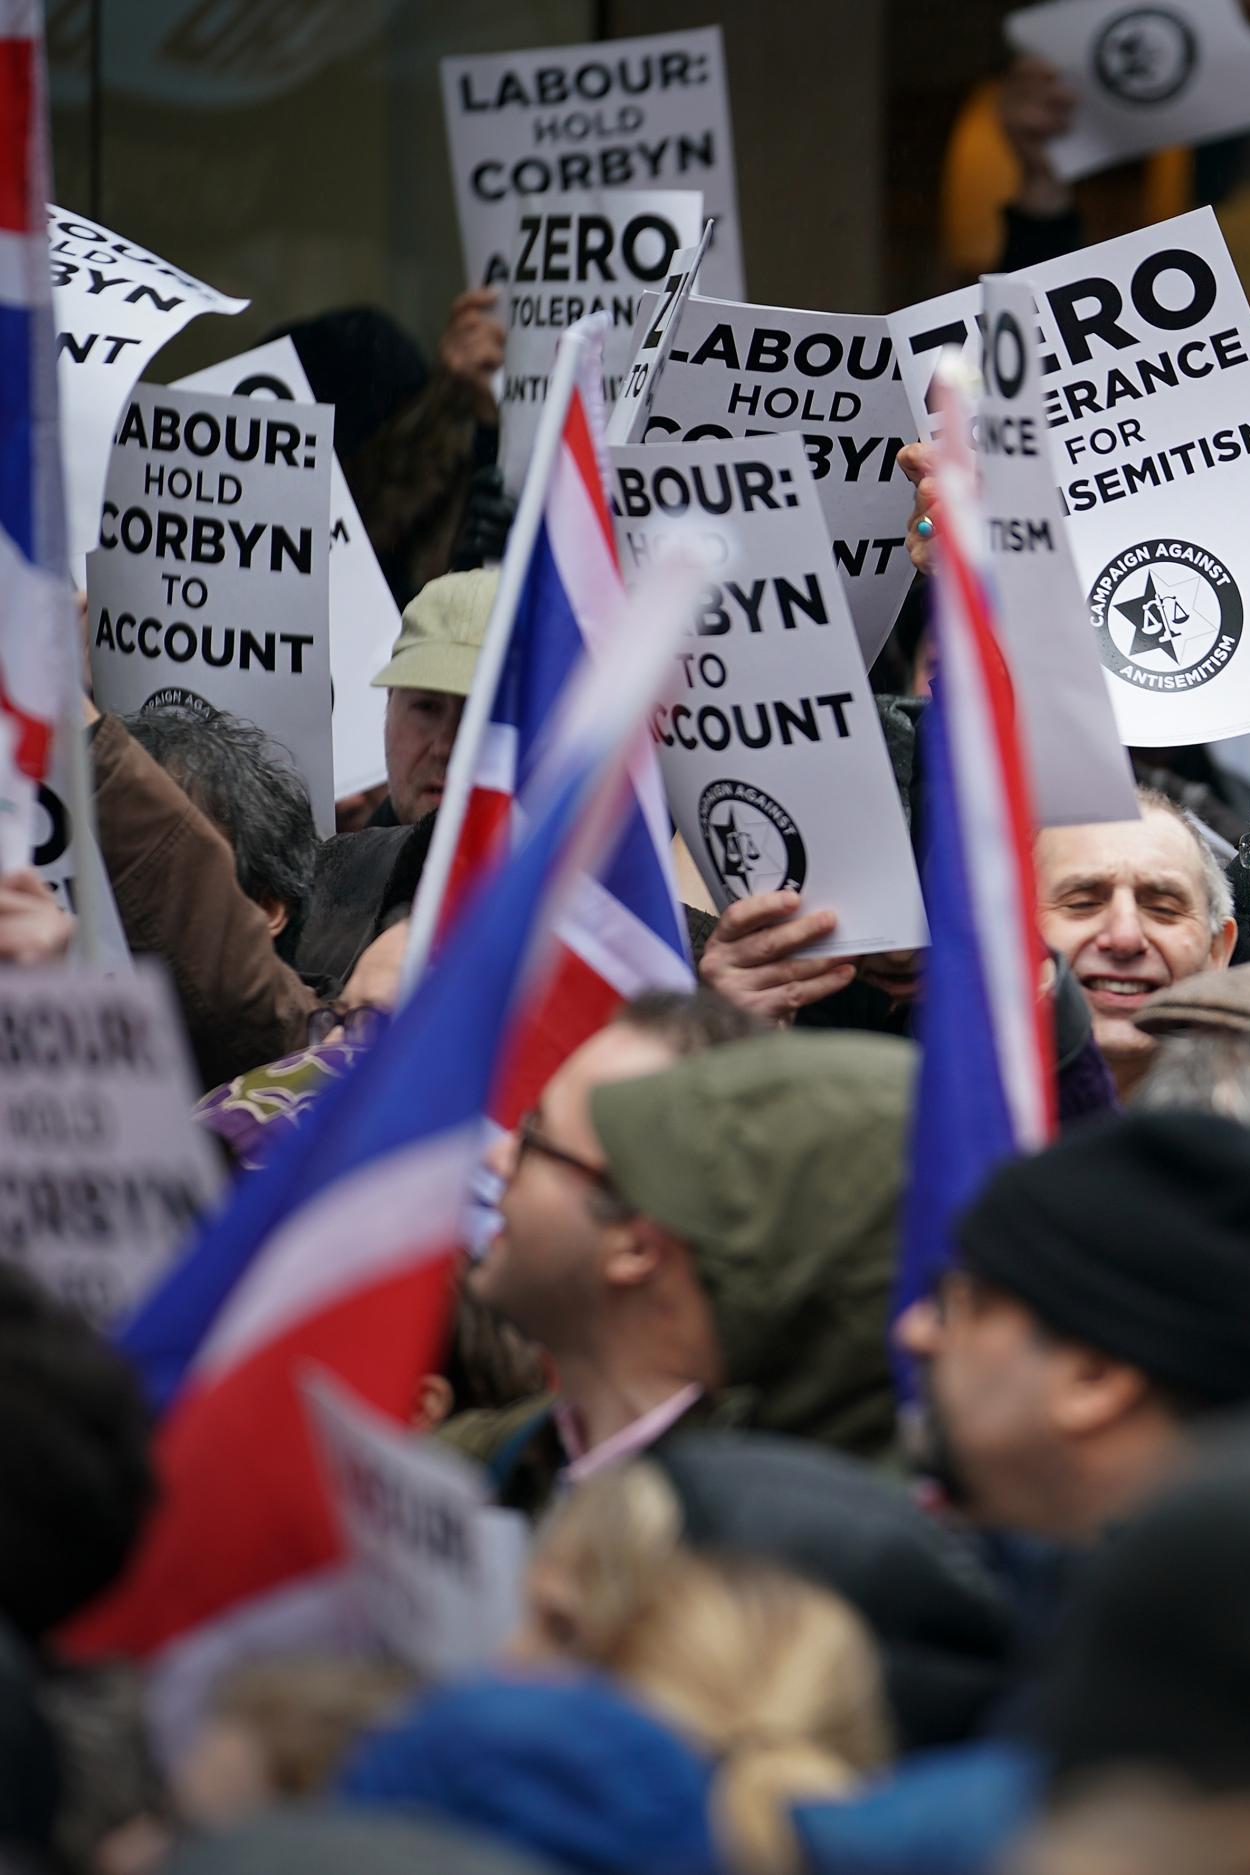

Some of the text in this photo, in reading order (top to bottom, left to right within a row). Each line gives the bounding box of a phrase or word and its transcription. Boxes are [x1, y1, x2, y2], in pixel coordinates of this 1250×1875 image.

[459, 51, 709, 113] LABOUR:
[532, 104, 645, 144] HOLD
[470, 130, 714, 202] CORBYN
[514, 213, 681, 283] ZERO
[728, 383, 862, 422] HOLD
[1046, 327, 1249, 428] ERANCE
[114, 402, 317, 468] ABOUR:
[1064, 418, 1147, 465] FOR
[144, 463, 243, 505] HOLD
[612, 461, 799, 517] BOUR:
[162, 572, 209, 609] TO
[1090, 543, 1231, 628] CAMPAIGN AGAINST
[95, 607, 314, 674] ACCOUNT
[1119, 634, 1236, 689] ANTISEMITISM
[675, 653, 727, 688] TO
